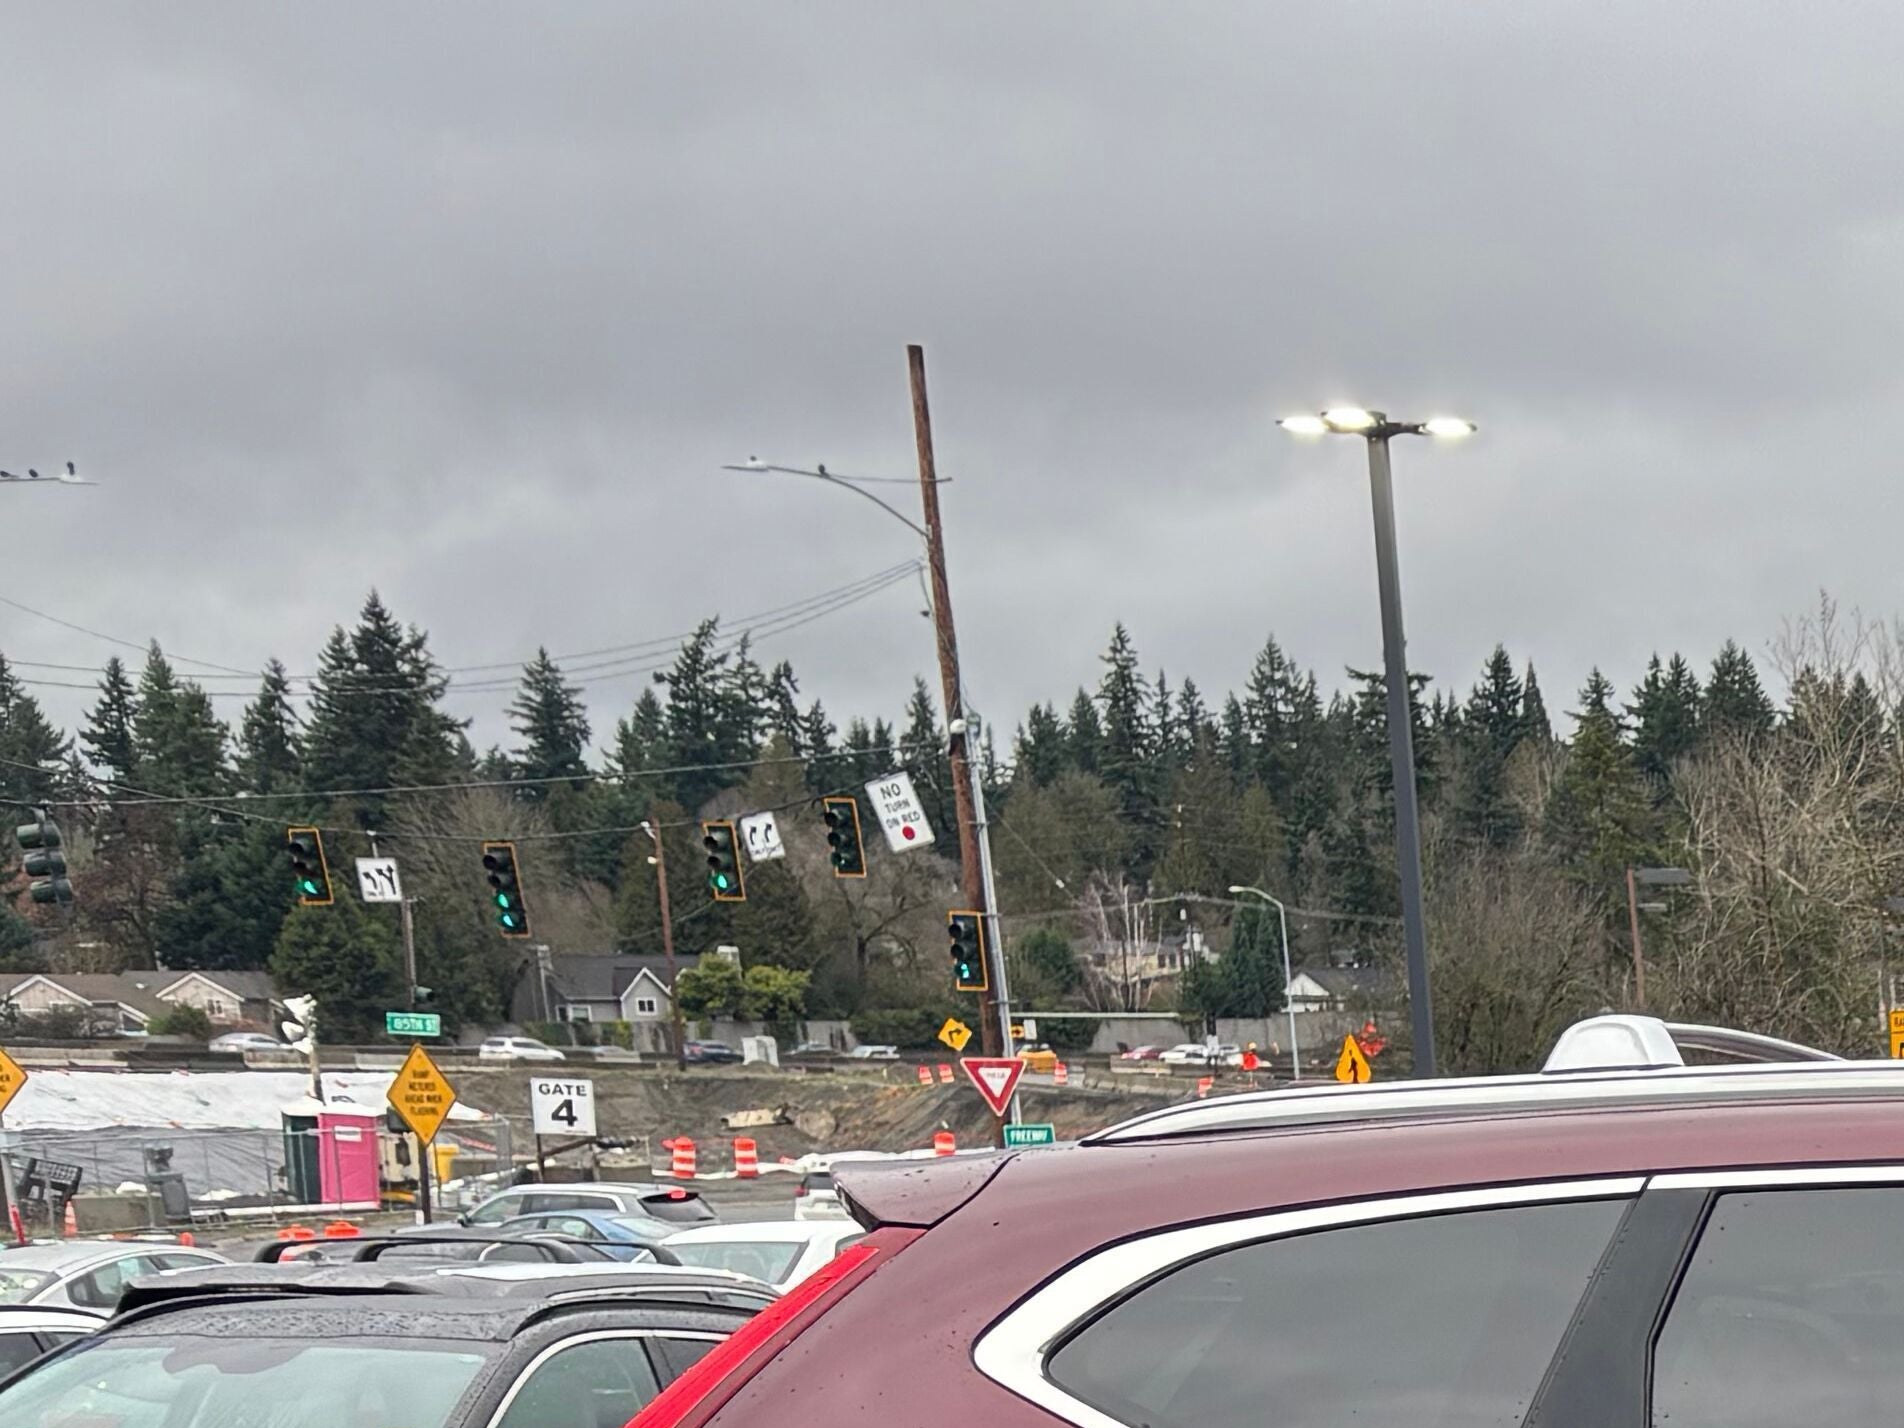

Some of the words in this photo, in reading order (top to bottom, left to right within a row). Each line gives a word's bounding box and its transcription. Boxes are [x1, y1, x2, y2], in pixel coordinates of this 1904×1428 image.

[880, 783, 901, 800] NO
[884, 799, 910, 814] TURN
[886, 817, 900, 829] ON
[901, 811, 921, 823] RED
[538, 1083, 588, 1097] GATE
[551, 1099, 579, 1127] 4
[1010, 1129, 1049, 1142] FREEWAY
